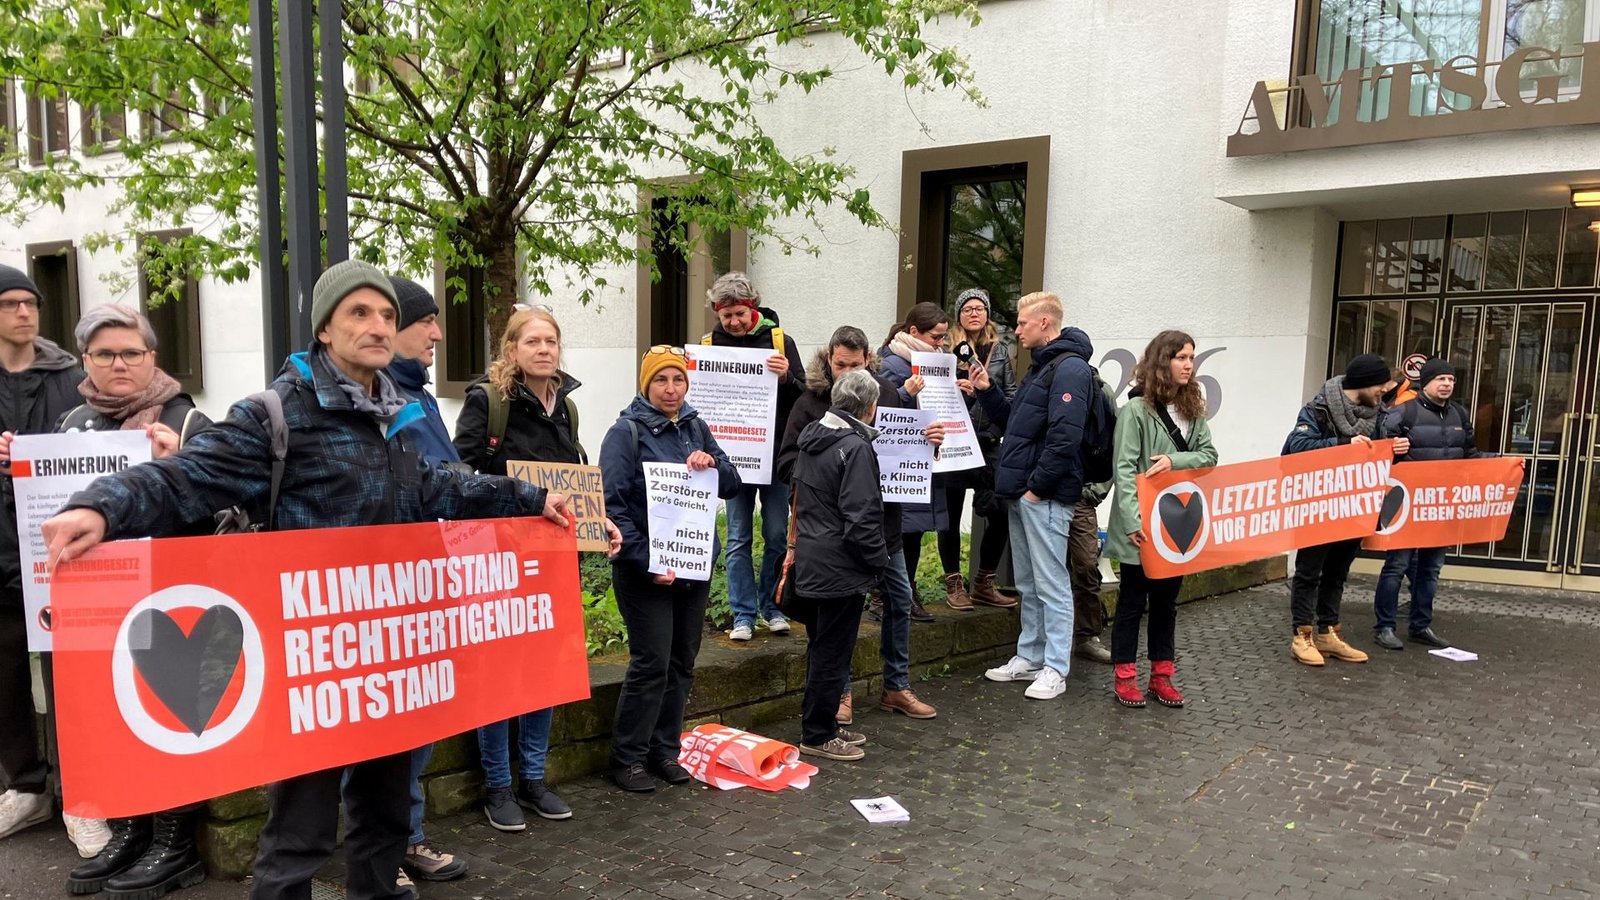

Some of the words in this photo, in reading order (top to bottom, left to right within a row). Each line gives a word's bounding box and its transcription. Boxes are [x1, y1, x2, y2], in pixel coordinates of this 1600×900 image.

[1230, 41, 1600, 138] AMTSG
[698, 359, 764, 375] ERINNERUNG
[919, 365, 950, 377] ERINNERUNG
[880, 412, 918, 424] Klima-
[719, 425, 767, 436] GRUNDGESETZ
[879, 425, 927, 436] Zerstöre
[897, 438, 929, 447] Gericht,
[34, 454, 129, 477] ERINNERUNG
[649, 467, 692, 480] Klima-
[899, 460, 929, 470] nicht
[890, 472, 928, 482] Klima-
[650, 480, 711, 500] Zerstörer
[880, 484, 927, 496] Aktiven!
[1211, 478, 1277, 516] LETZTE
[1280, 459, 1391, 504] GENERATION
[1413, 486, 1449, 505] ART.
[1451, 485, 1482, 504] 20A
[1485, 484, 1505, 501] GG
[651, 495, 672, 505] vor's
[673, 498, 708, 512] Gericht,
[1412, 506, 1454, 522] LEBEN
[1456, 501, 1514, 520] SCHÜTZEN
[676, 528, 710, 541] nicht
[1211, 515, 1245, 545] VOR
[1248, 508, 1281, 537] DEN
[651, 538, 664, 550] die
[666, 541, 708, 556] Klima-
[659, 554, 707, 571] Aktiven!
[279, 550, 519, 620] KLIMANOTSTAND
[283, 592, 555, 678] RECHTFERTIGENDER
[288, 658, 456, 735] NOTSTAND
